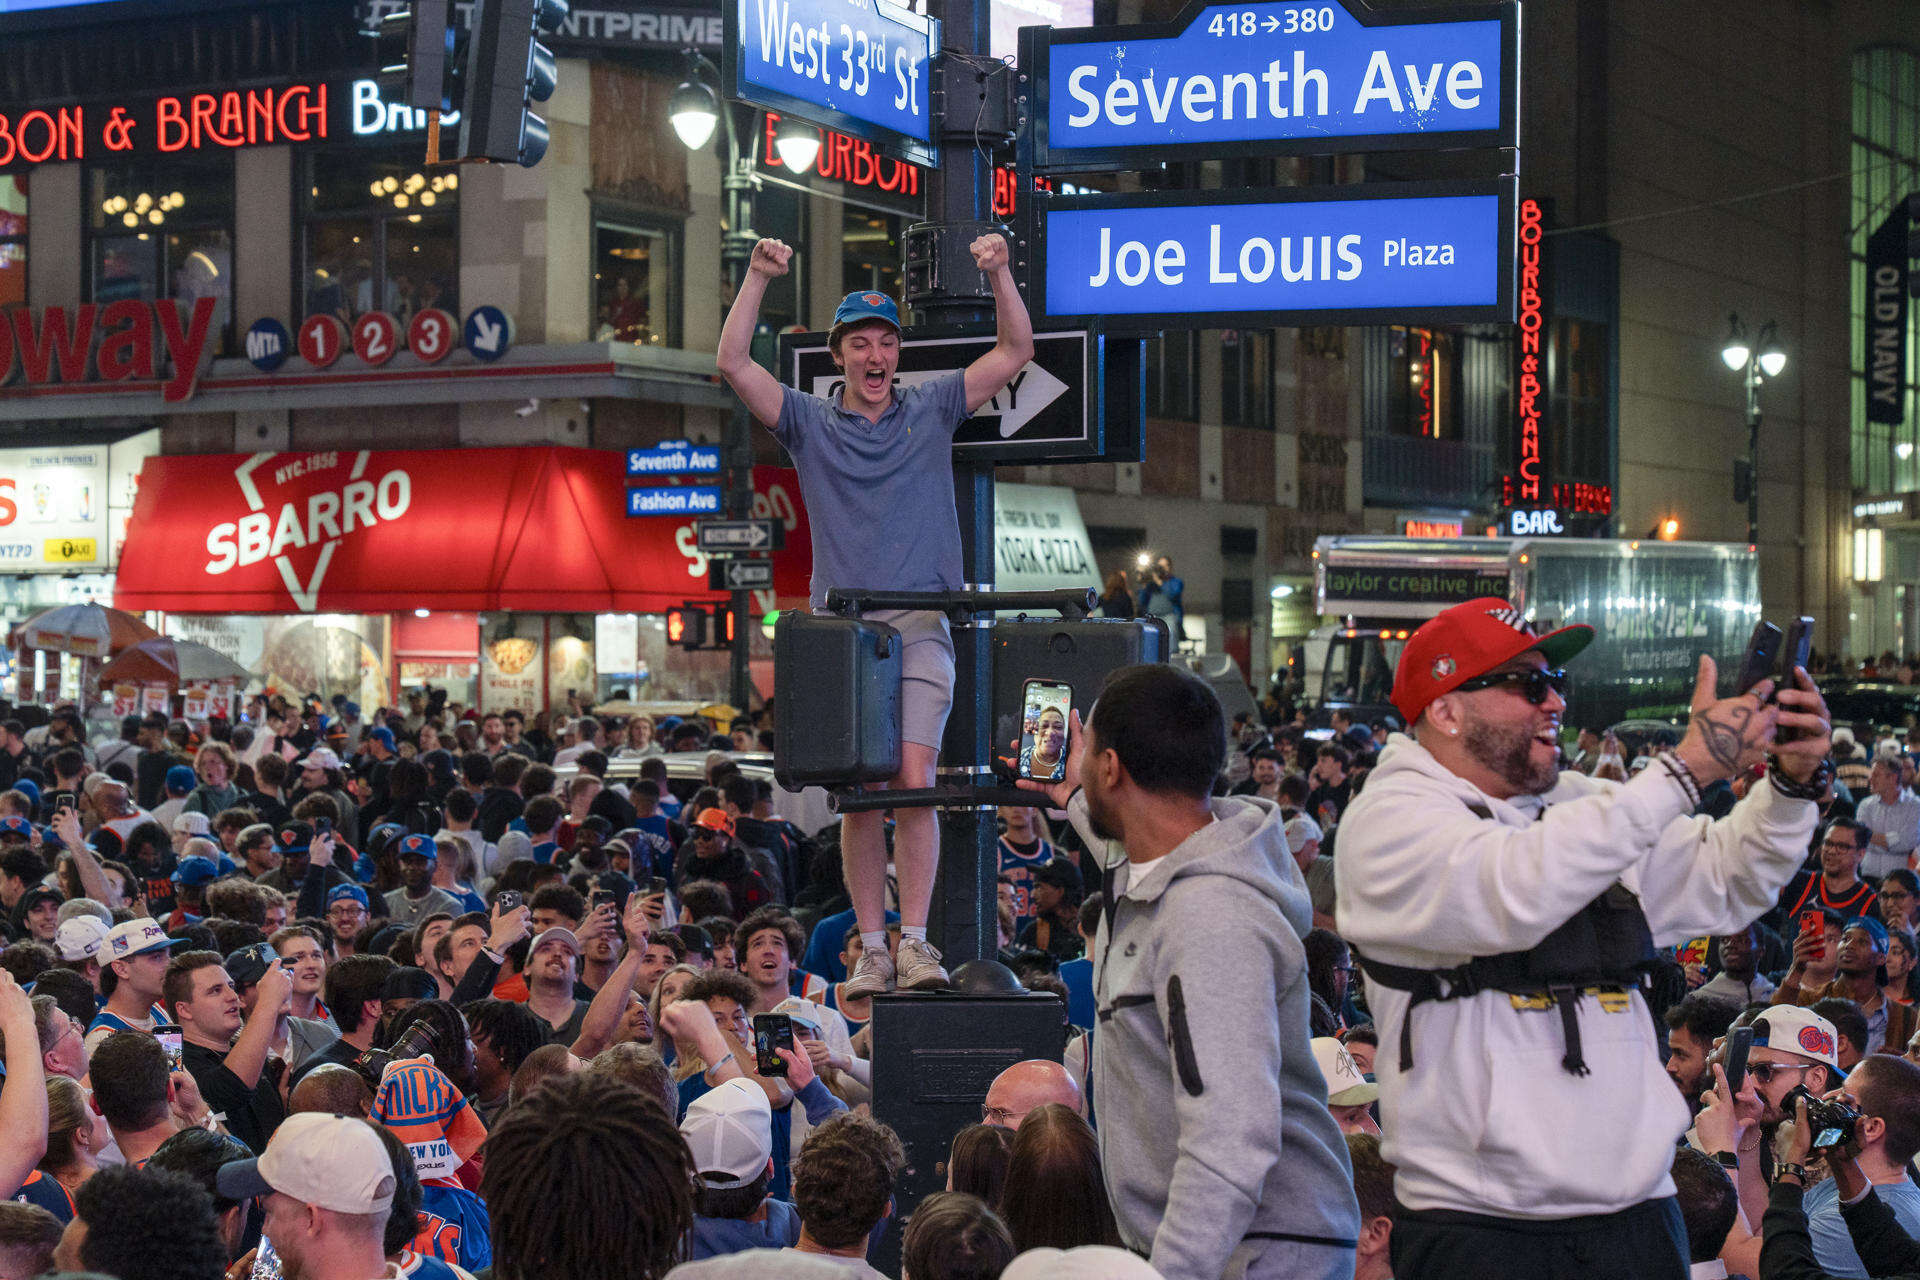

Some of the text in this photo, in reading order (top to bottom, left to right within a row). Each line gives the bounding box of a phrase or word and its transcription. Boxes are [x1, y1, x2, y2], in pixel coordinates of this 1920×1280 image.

[1207, 7, 1335, 37] 418 380
[757, 0, 919, 116] West 33rd St
[1068, 50, 1483, 128] Seventh Ave
[103, 107, 137, 151] &
[157, 84, 328, 152] BRANCH
[1089, 224, 1455, 288] Joe Louis Plaza
[247, 318, 441, 361] MTA 1 2 3
[1519, 199, 1543, 500] BOURBON & BRANCH
[1872, 265, 1900, 404] OLD NAVY
[630, 451, 718, 471] Seventh Ave
[204, 469, 411, 575] SBARRO
[632, 490, 717, 511] Fashion Ave
[1512, 510, 1564, 535] BAR
[1326, 571, 1381, 598] taylor
[1389, 575, 1468, 594] creative
